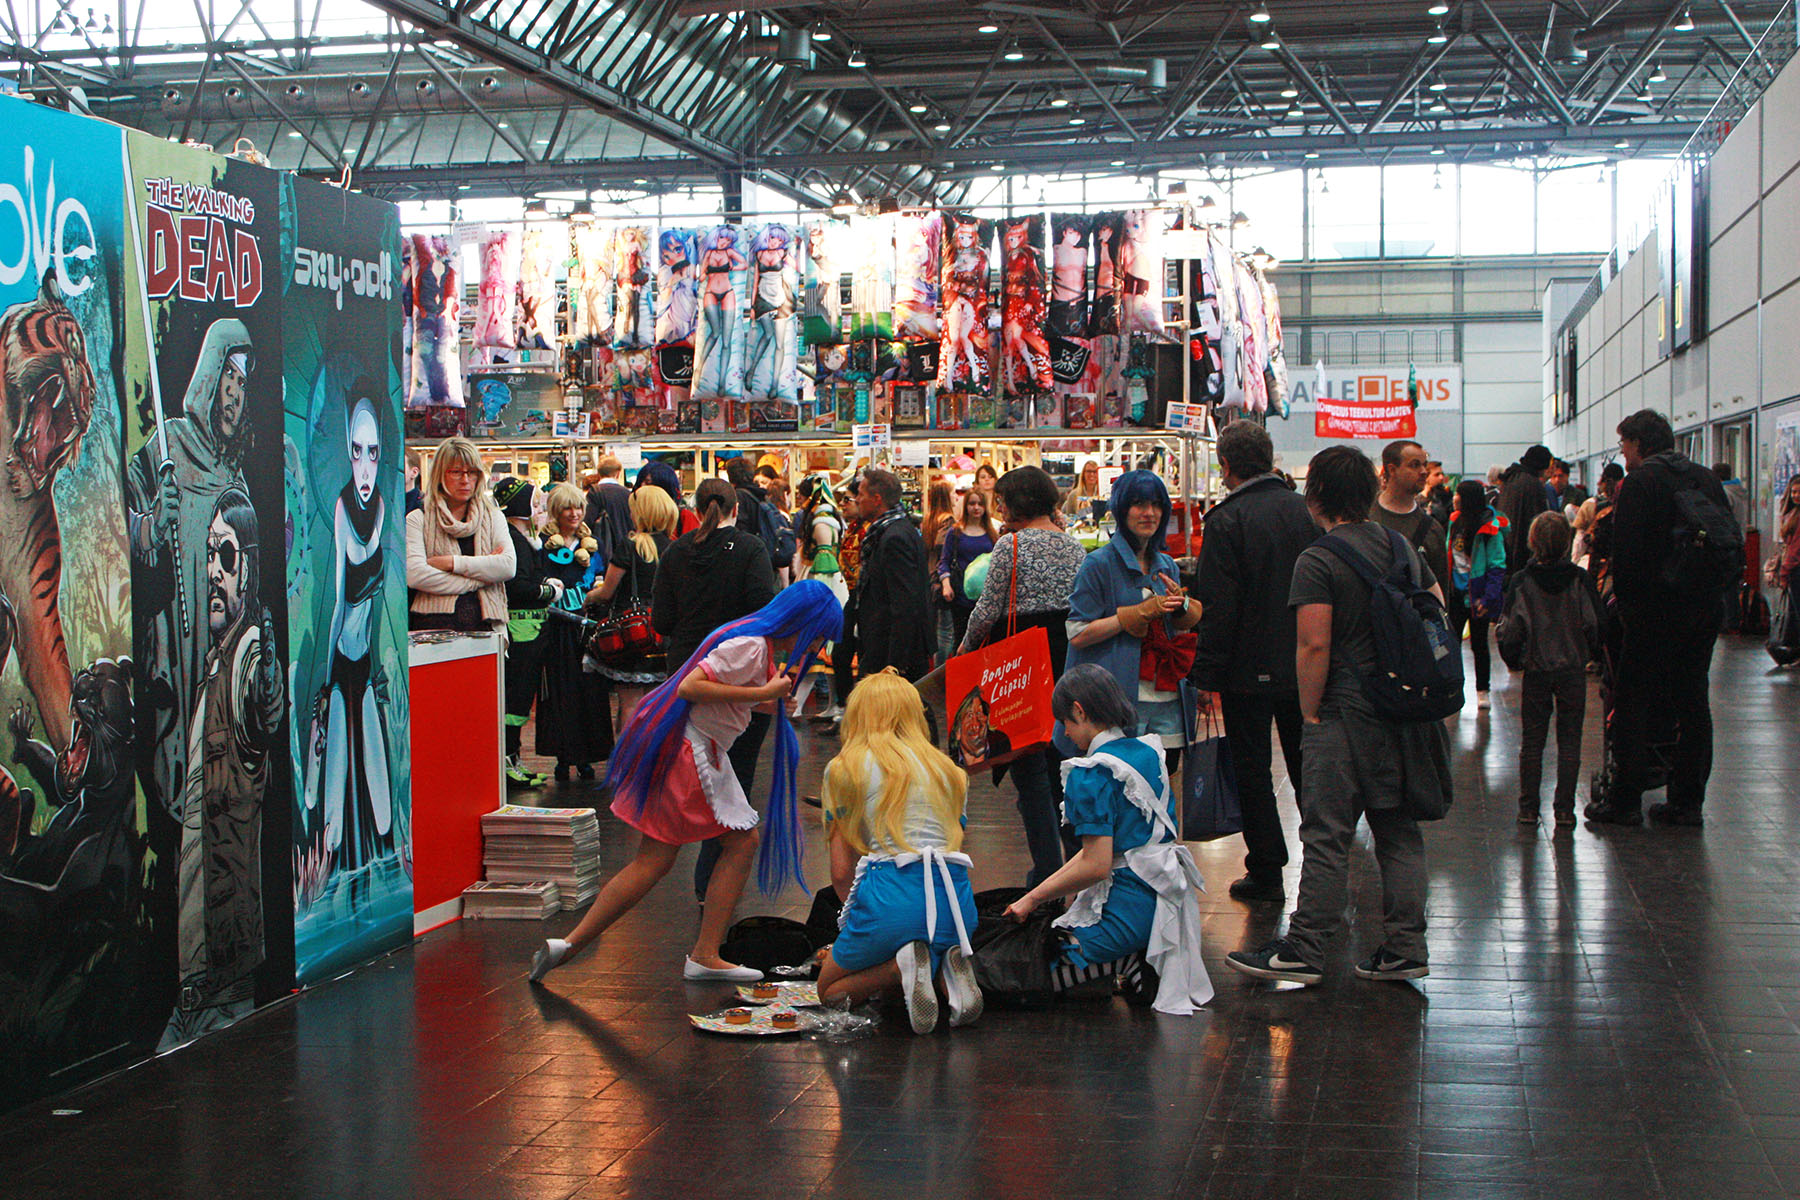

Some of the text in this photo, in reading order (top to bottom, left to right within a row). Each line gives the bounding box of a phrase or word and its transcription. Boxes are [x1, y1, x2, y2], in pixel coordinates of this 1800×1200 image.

[144, 177, 255, 225] THE WALKING
[145, 202, 263, 308] DEAD
[1391, 379, 1450, 401] ENS
[981, 656, 1023, 686] Bonjour
[990, 666, 1032, 704] Leipzig!
